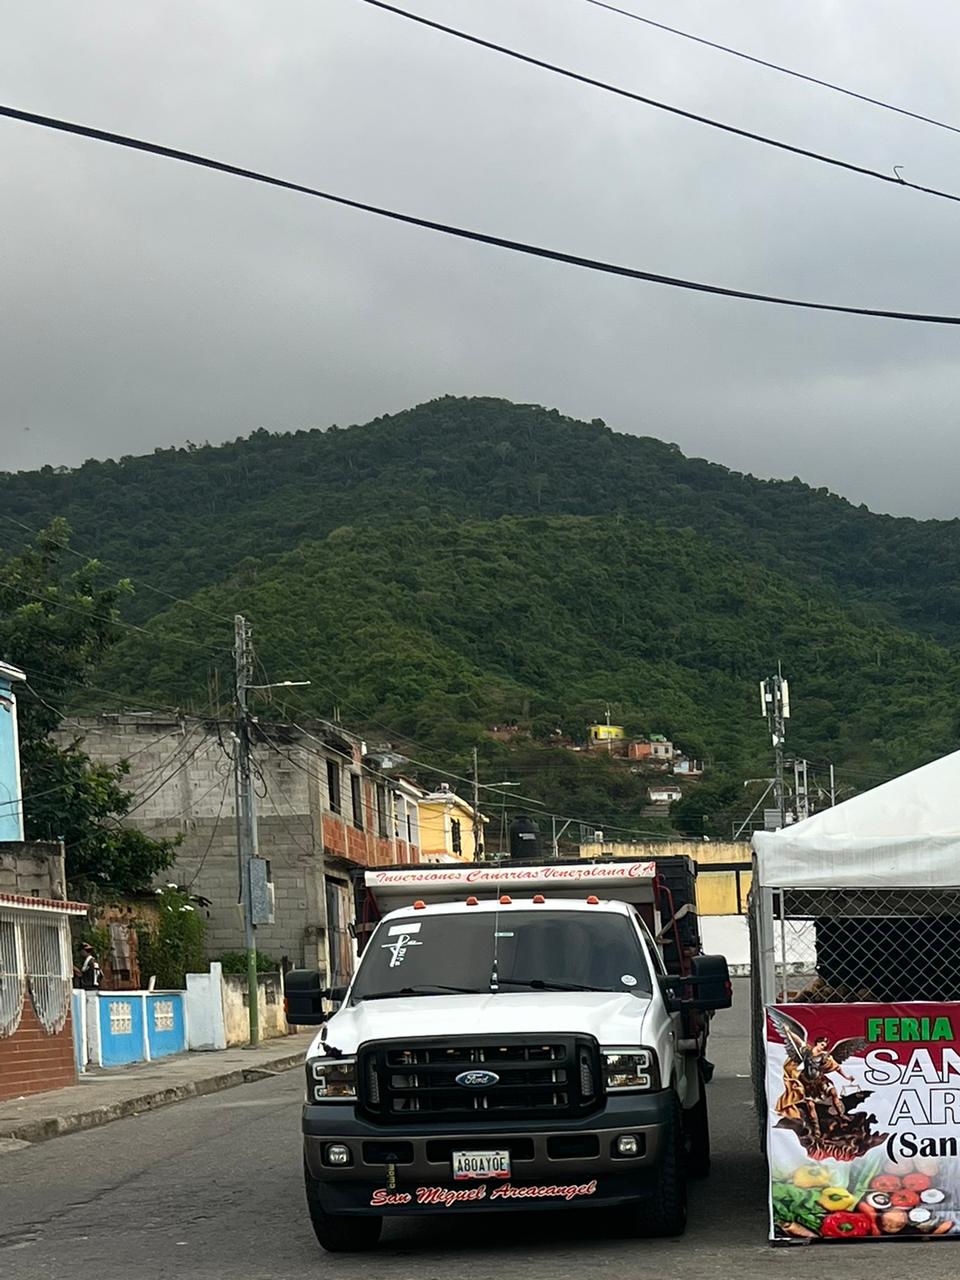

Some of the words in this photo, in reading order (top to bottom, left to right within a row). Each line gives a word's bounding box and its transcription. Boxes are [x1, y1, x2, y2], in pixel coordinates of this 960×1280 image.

[376, 872, 462, 883] Inversiones
[465, 870, 539, 883] Canarias
[540, 866, 625, 881] Venezolana
[867, 1016, 954, 1042] FERIA
[465, 1073, 489, 1084] Ford
[886, 1131, 957, 1164] (San
[370, 1188, 411, 1206] San
[416, 1184, 486, 1207] Miguel
[490, 1179, 598, 1201] Arcacangel
